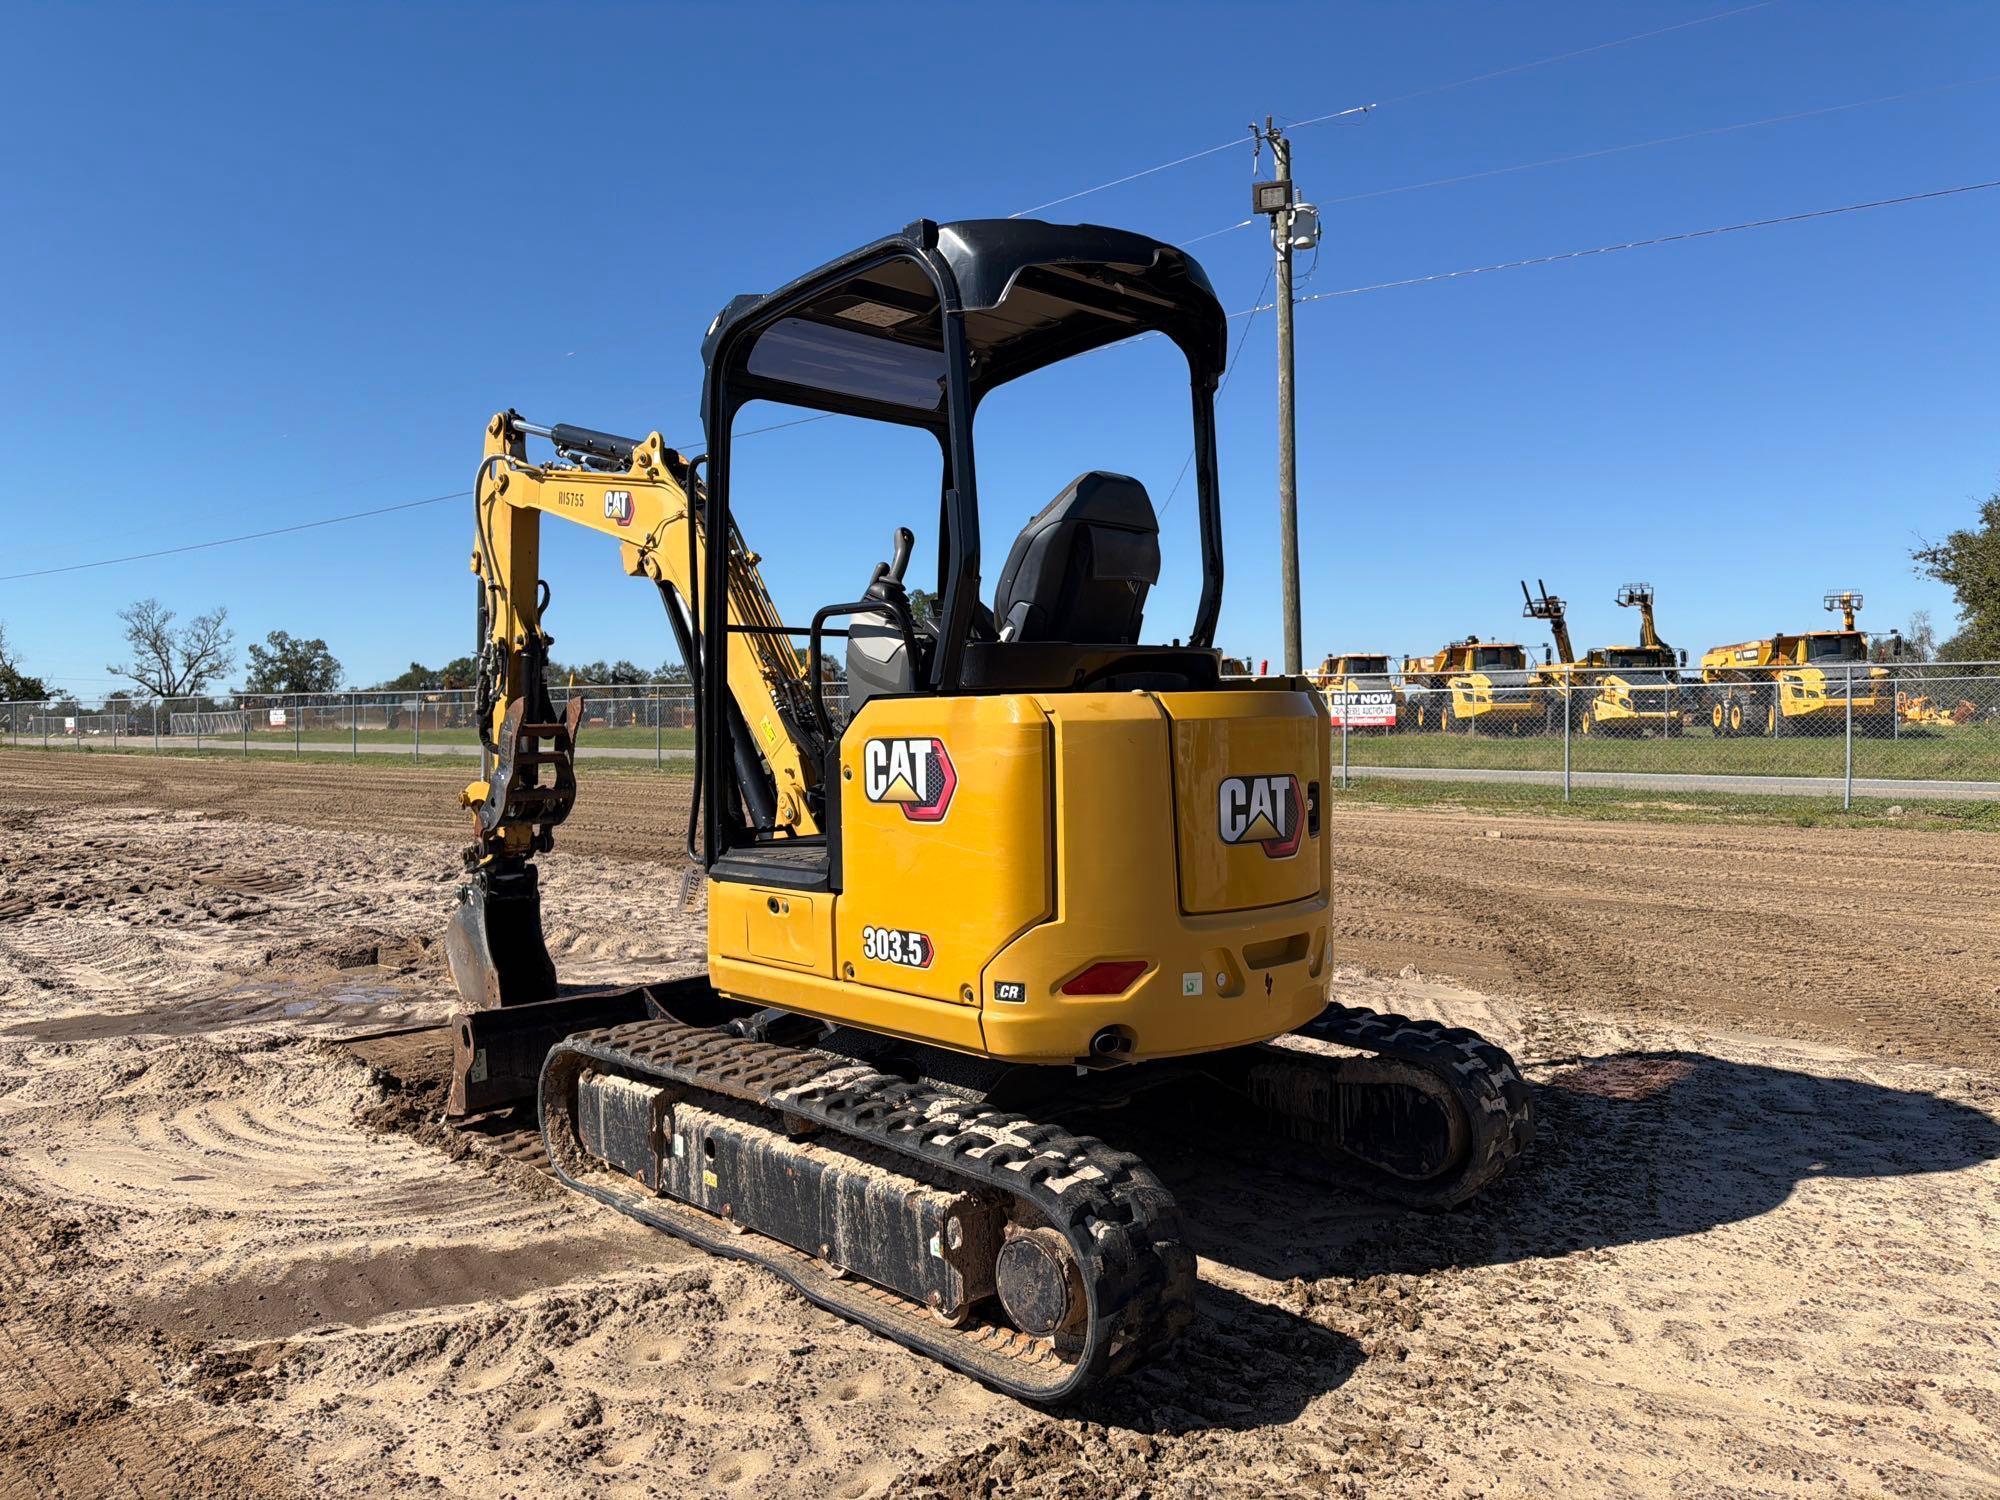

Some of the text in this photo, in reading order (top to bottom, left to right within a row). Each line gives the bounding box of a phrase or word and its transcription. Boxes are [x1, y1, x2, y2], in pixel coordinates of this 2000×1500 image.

[605, 491, 628, 518] CAT
[1333, 693, 1393, 705] BUY NOW
[1345, 706, 1361, 716] EBEL
[865, 739, 932, 802] CAT
[1220, 776, 1290, 842] CAT
[863, 926, 922, 966] 303.5
[1000, 984, 1020, 999] CR
